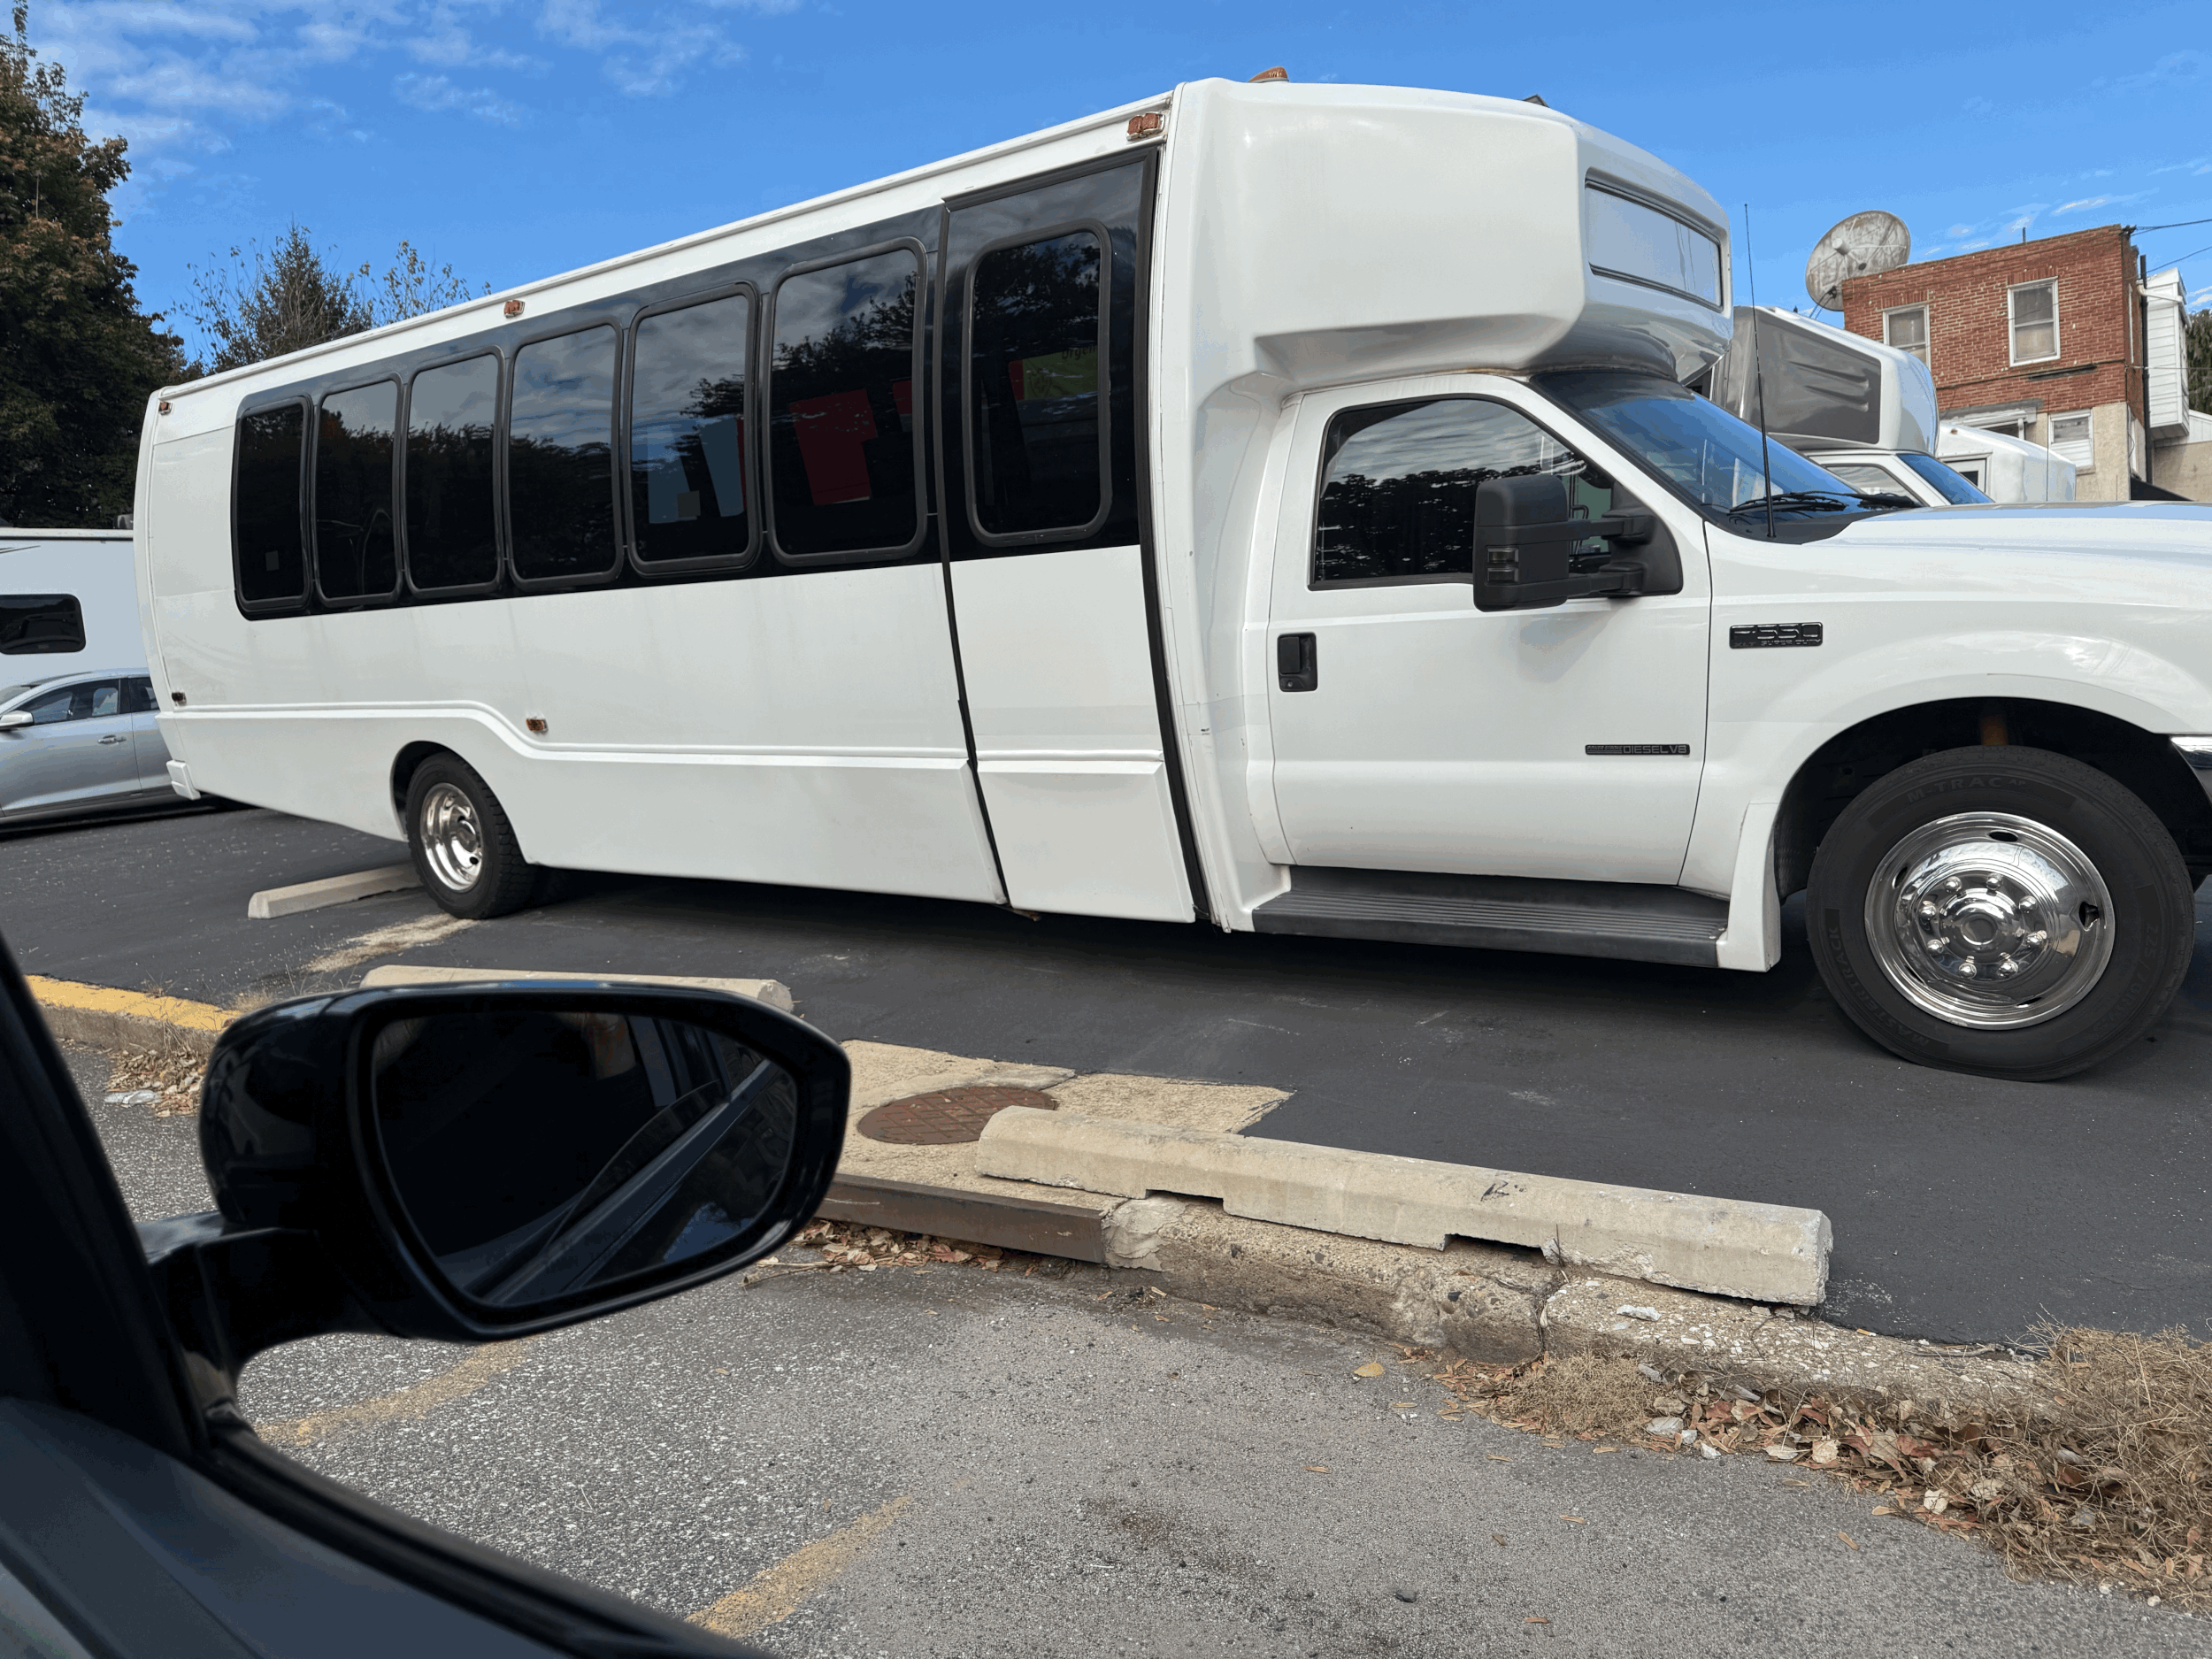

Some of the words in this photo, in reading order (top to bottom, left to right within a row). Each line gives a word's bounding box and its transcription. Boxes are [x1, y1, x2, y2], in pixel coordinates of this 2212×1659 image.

[1623, 745, 1669, 754] DIESEL
[1669, 745, 1687, 754] V8
[1906, 777, 2003, 803] M-TRAC
[1827, 926, 1931, 1047] MASTERTRACK
